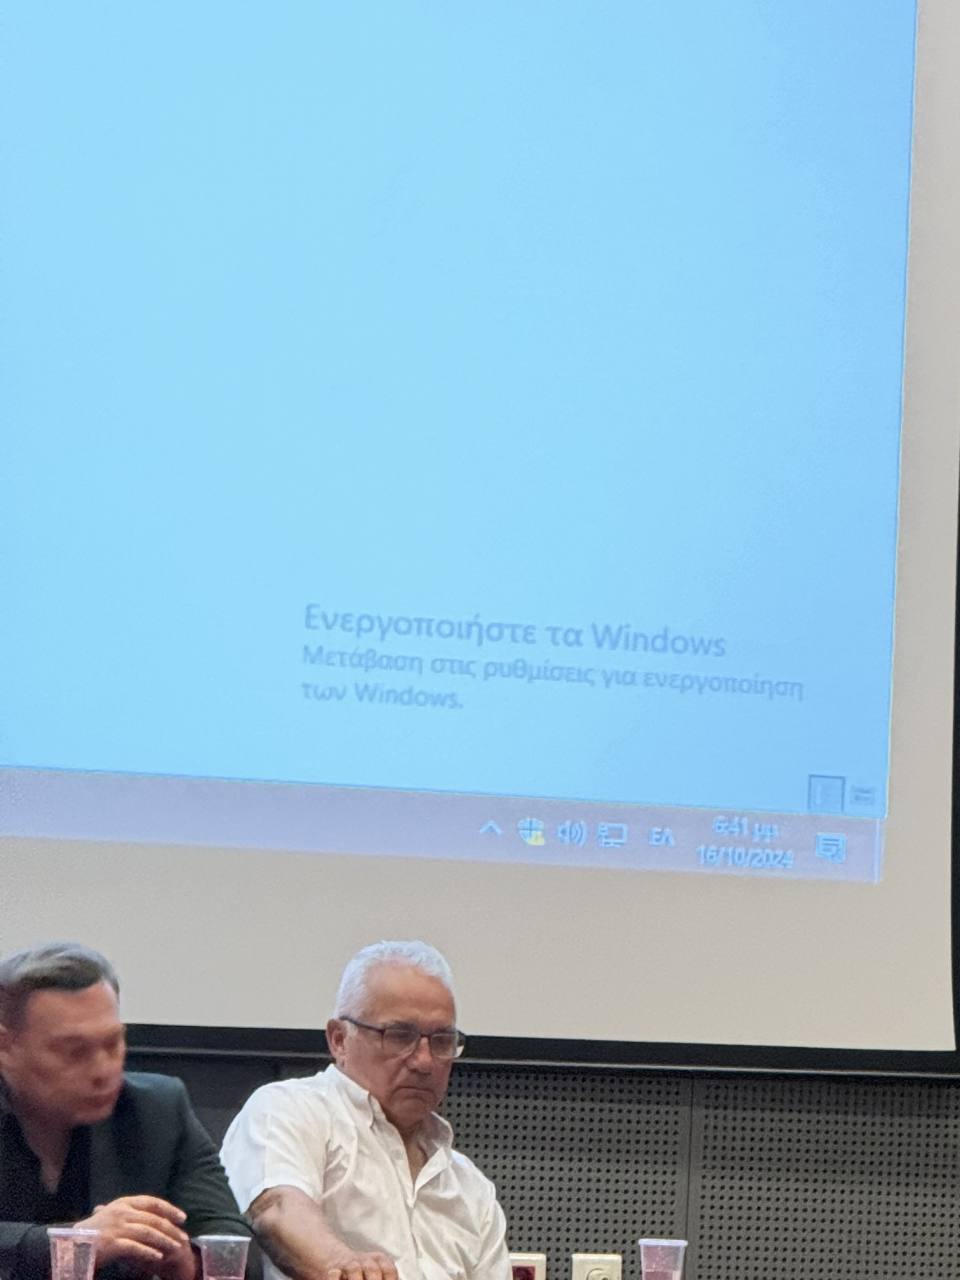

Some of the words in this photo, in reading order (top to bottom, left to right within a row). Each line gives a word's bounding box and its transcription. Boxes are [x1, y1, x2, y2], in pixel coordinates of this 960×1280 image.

[304, 603, 537, 647] Ενεργοποιήστε
[545, 624, 584, 647] τα
[591, 622, 727, 658] Windows
[301, 682, 347, 701] των
[354, 682, 464, 709] Windows.
[302, 645, 424, 676] Μετάβαση
[430, 657, 477, 678] στις
[483, 657, 596, 687] ρυθμίσεις
[601, 668, 639, 689] για
[643, 671, 804, 702] ενεργοποίηση
